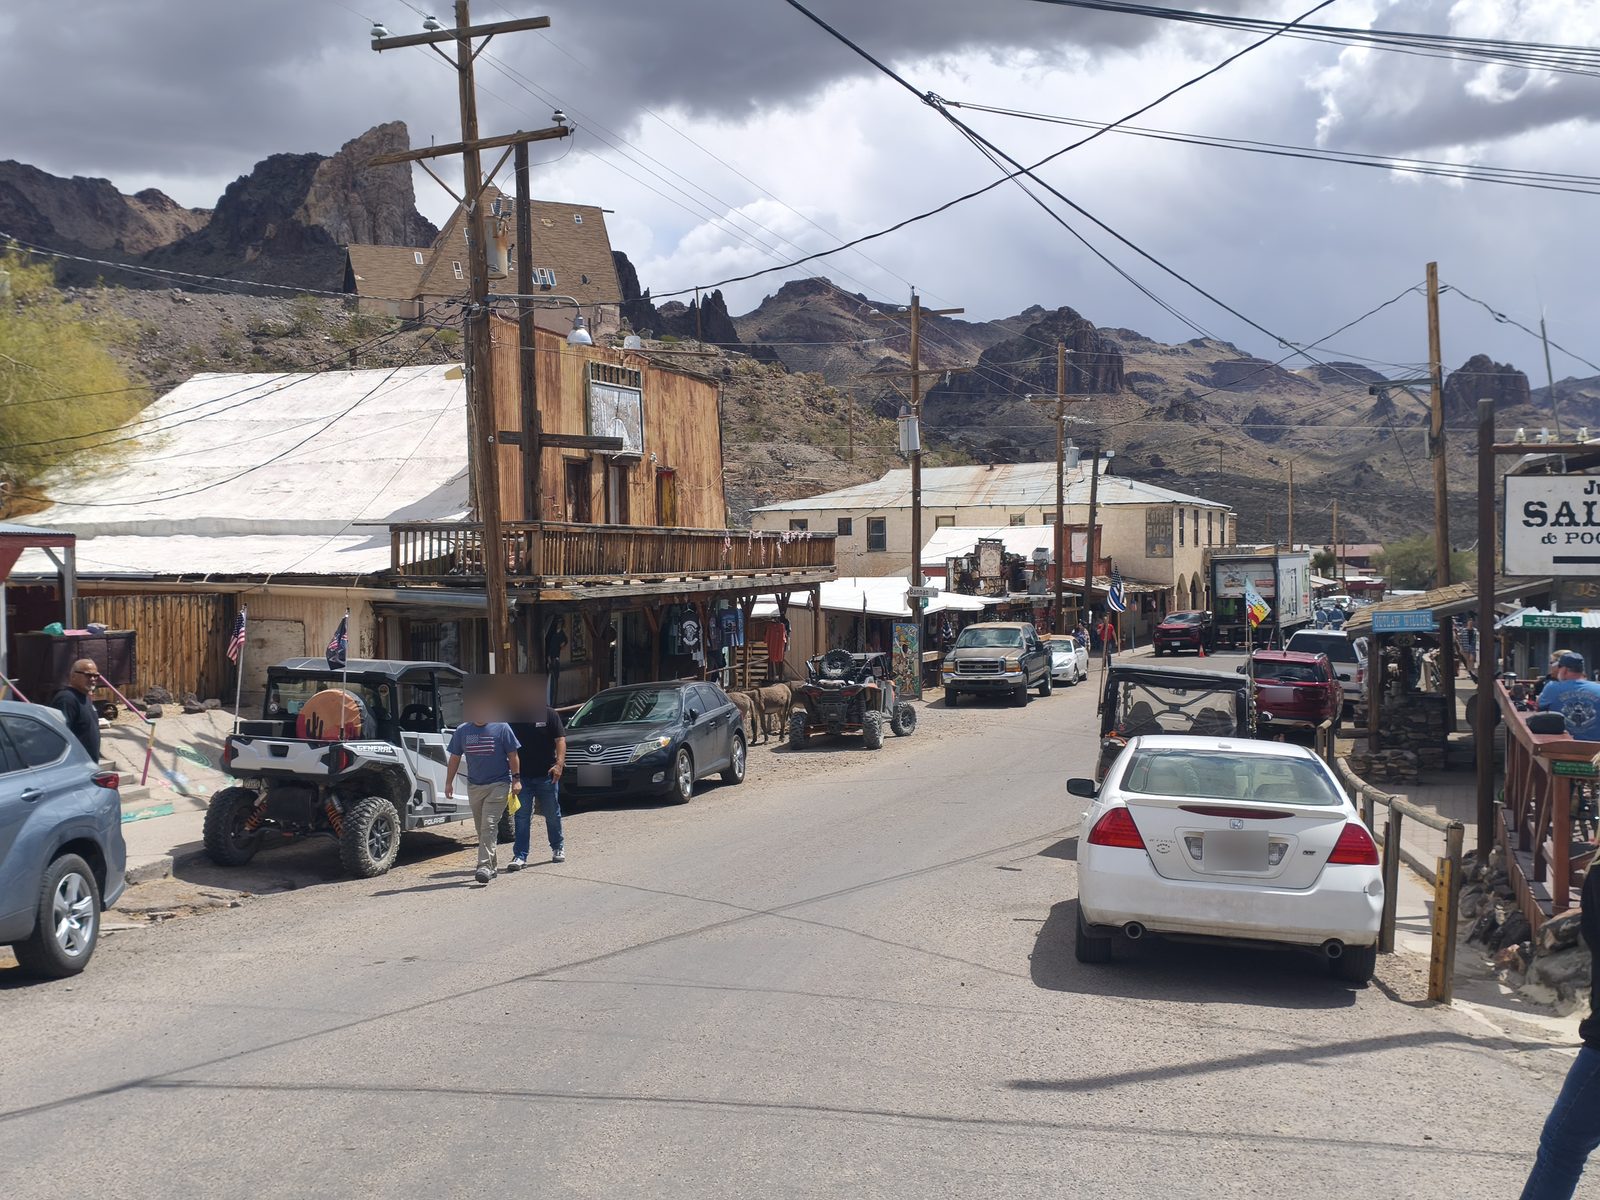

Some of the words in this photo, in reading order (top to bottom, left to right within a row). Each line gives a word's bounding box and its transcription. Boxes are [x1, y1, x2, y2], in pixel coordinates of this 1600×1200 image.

[1147, 525, 1172, 537] SHOP
[1541, 533, 1557, 544] &
[1375, 615, 1400, 628] OUTLAW
[356, 745, 393, 753] GENERAL
[423, 816, 446, 826] POLARIS
